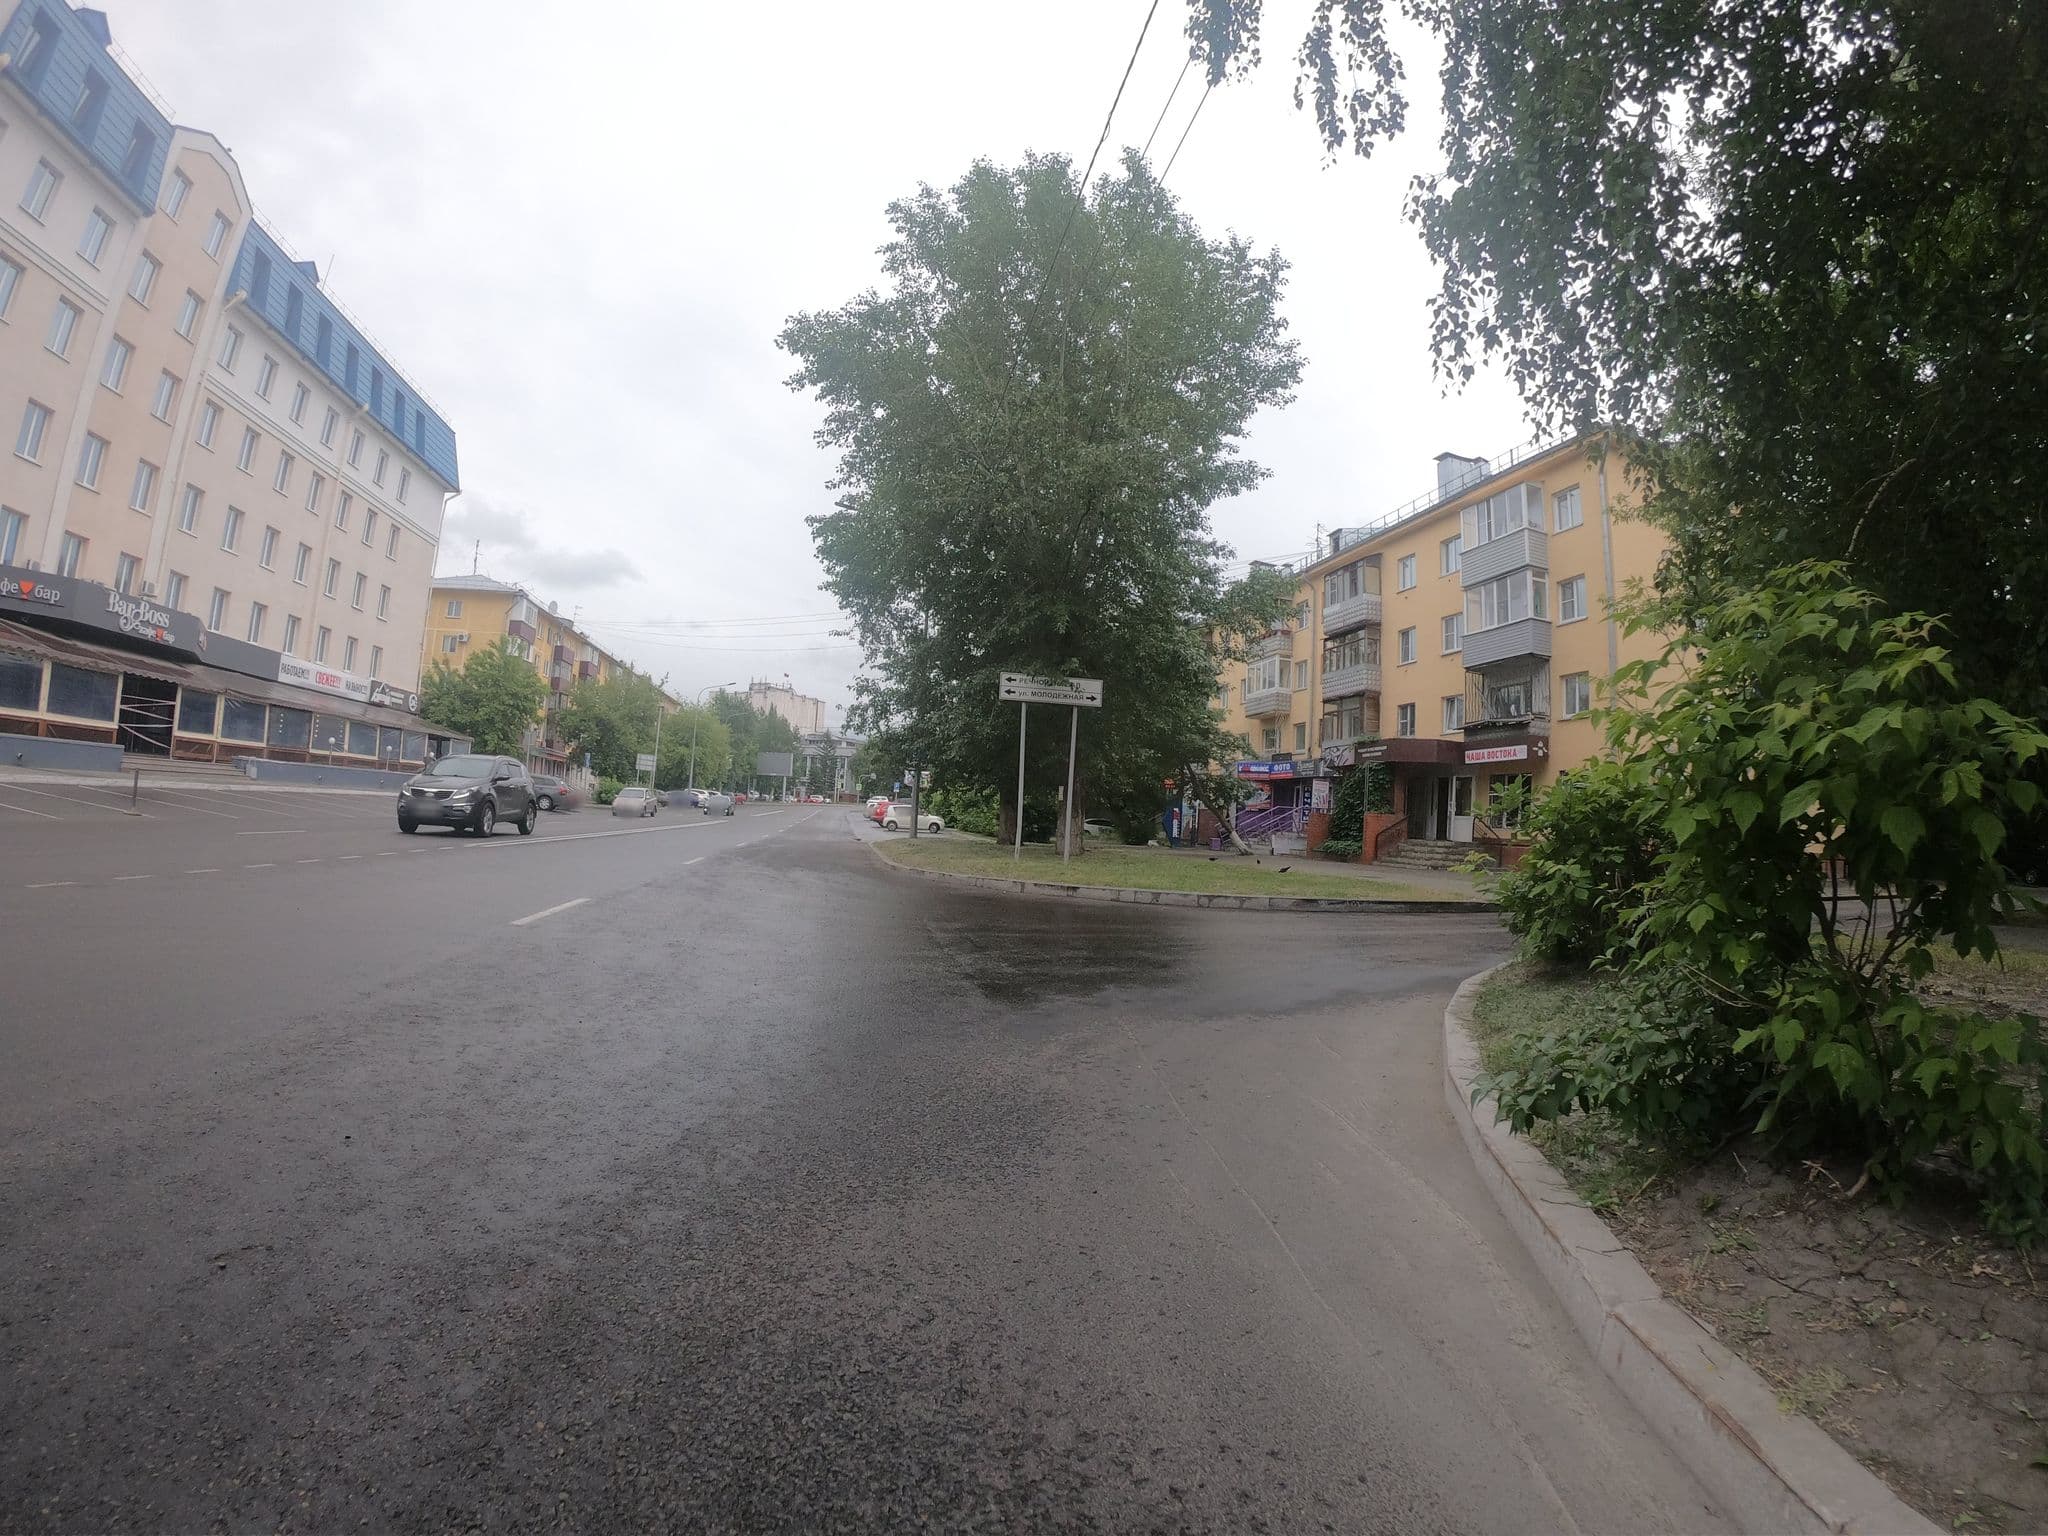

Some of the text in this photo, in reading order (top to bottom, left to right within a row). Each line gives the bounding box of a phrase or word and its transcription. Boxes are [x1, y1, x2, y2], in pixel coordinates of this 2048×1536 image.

[35, 585, 61, 604] бар
[138, 600, 170, 628] Boss
[1031, 691, 1084, 701] МОЛОДЕЖНАЯ
[1466, 748, 1517, 761] ЧАША ВОСТОКА
